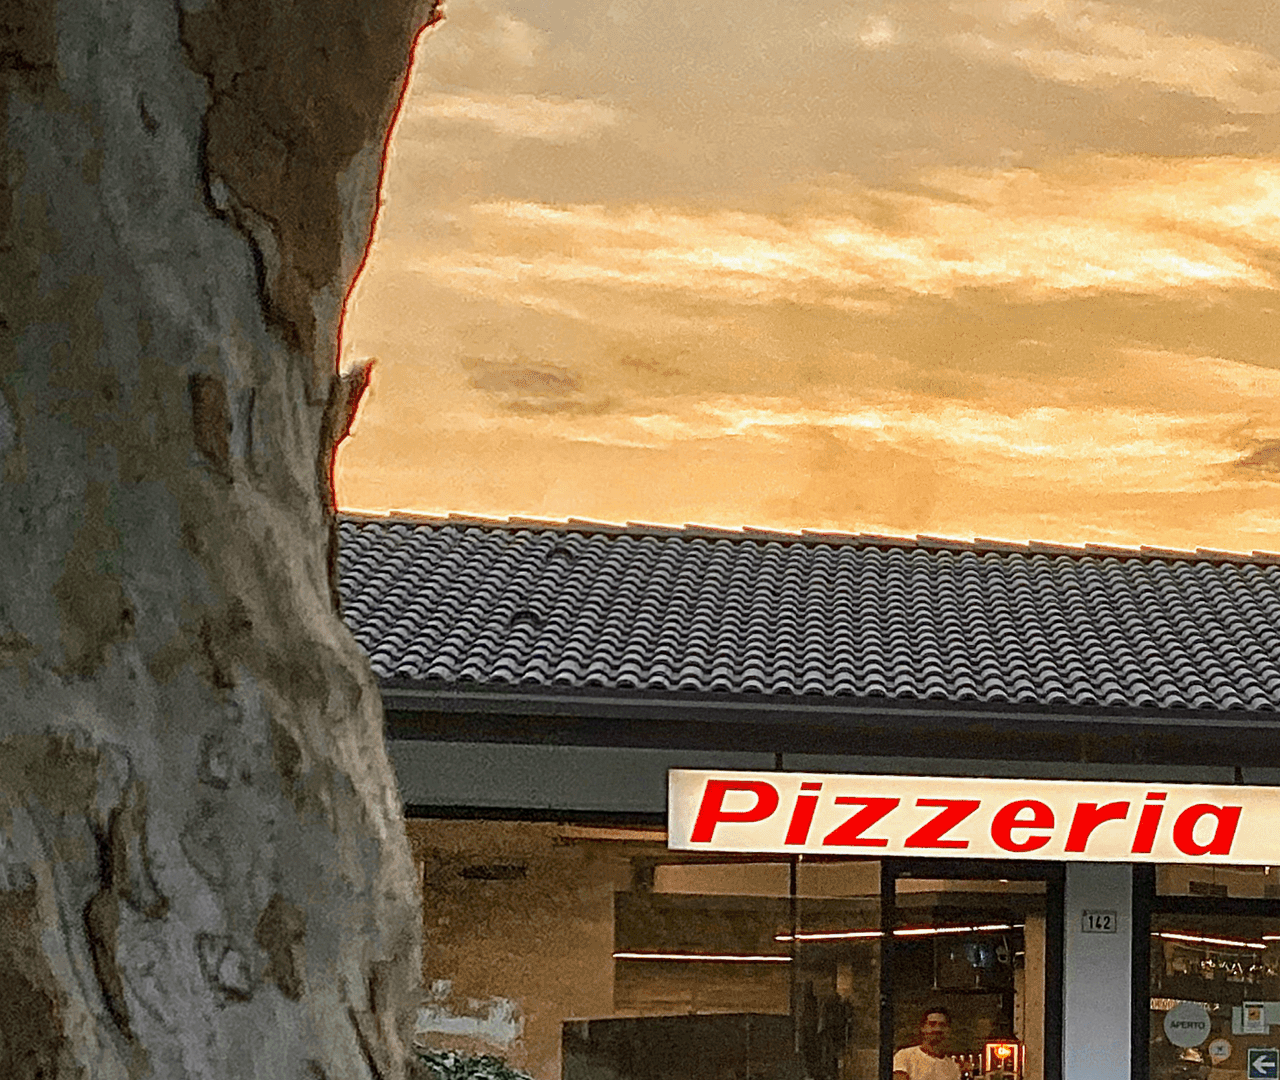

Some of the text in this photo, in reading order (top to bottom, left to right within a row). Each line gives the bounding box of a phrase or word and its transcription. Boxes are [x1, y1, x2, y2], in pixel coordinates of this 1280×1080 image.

[689, 779, 1243, 856] Pizzeria
[1088, 915, 1111, 930] 142
[1169, 1020, 1206, 1031] APERTO
